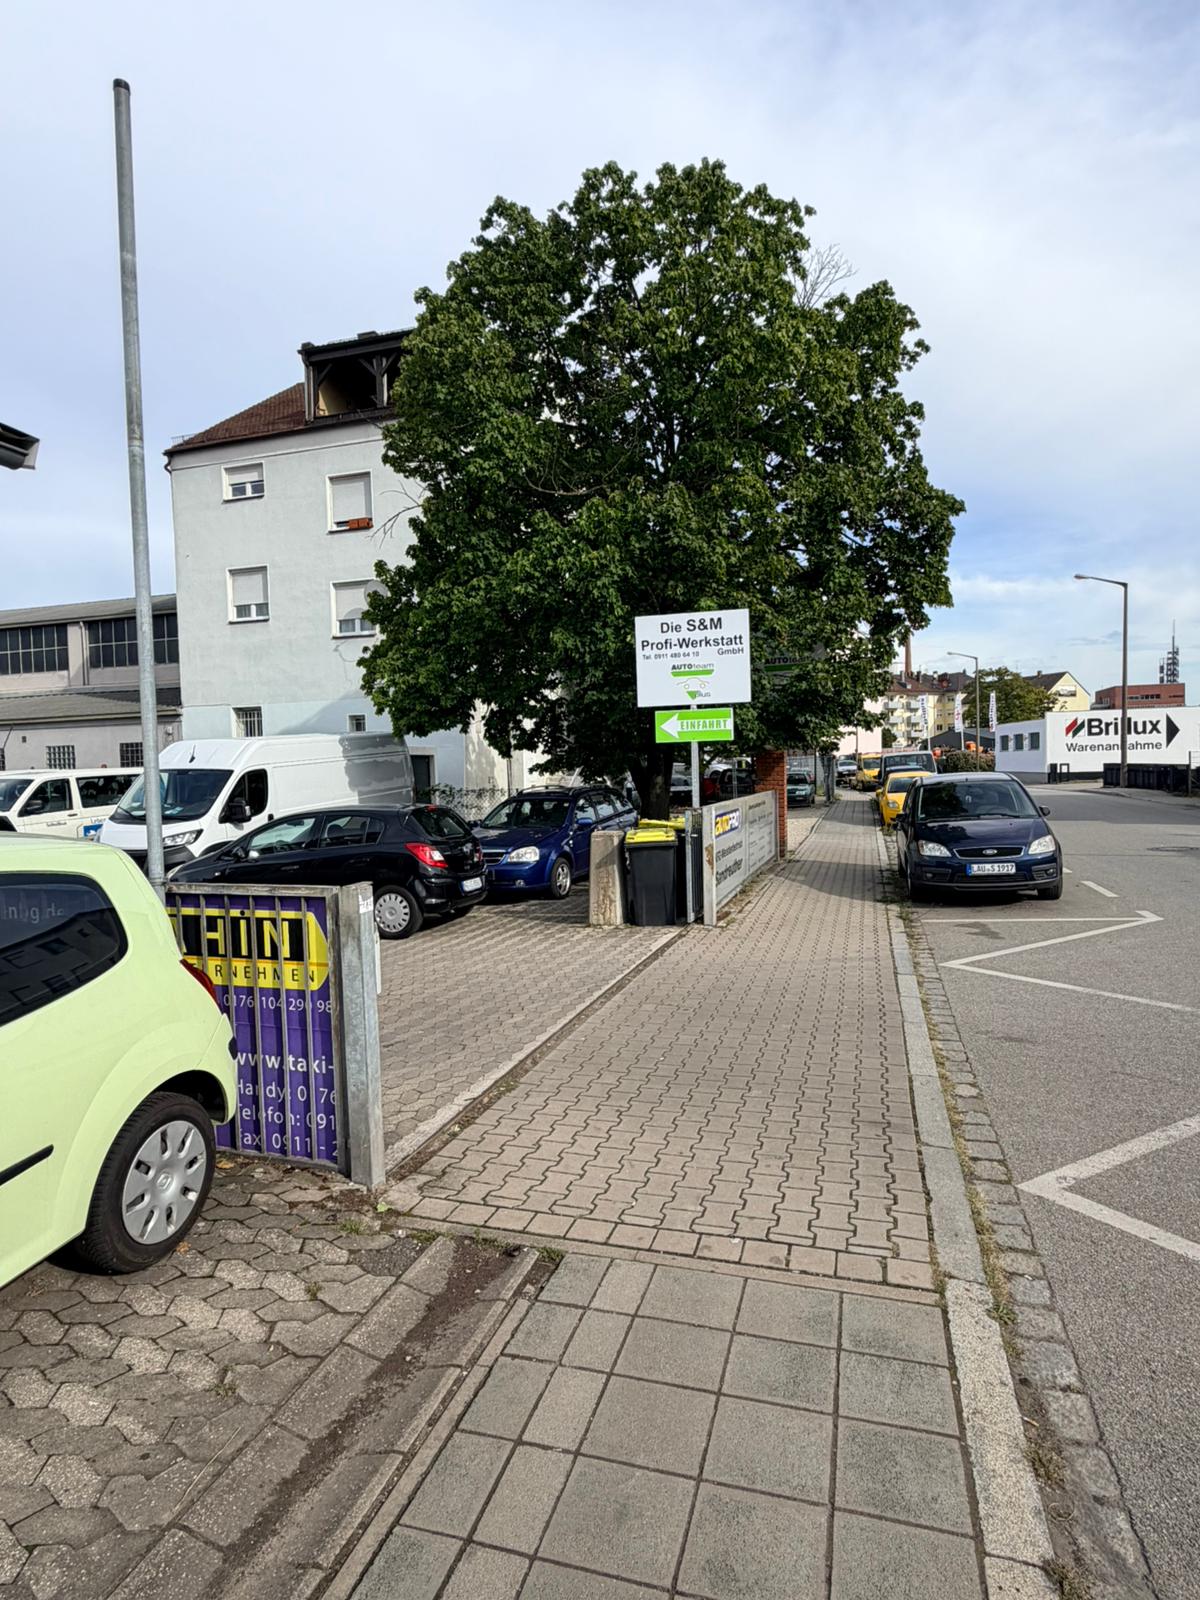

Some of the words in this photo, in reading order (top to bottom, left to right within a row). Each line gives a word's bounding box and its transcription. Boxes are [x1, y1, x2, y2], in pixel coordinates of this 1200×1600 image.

[660, 621, 682, 634] Die
[686, 617, 723, 632] S&M
[641, 634, 744, 651] Profi-Werkstatt
[717, 647, 744, 655] GmbH
[680, 719, 727, 730] EINFAHRT
[1087, 716, 1162, 736] Brilux
[1066, 741, 1163, 752] Warenanahme
[297, 1085, 336, 1104] 076
